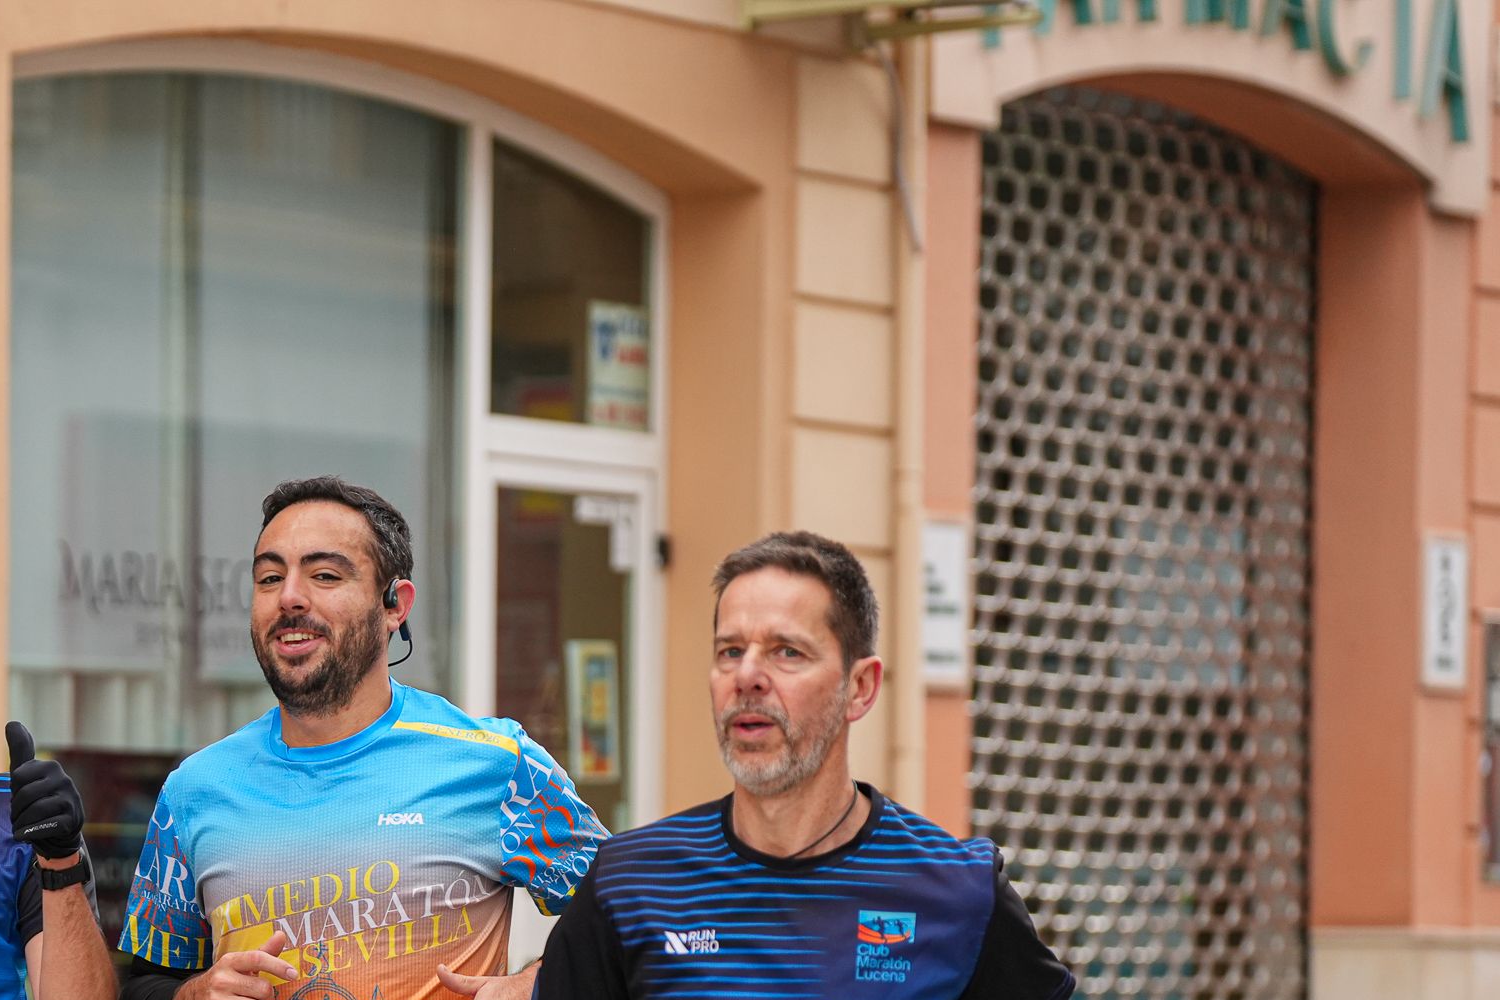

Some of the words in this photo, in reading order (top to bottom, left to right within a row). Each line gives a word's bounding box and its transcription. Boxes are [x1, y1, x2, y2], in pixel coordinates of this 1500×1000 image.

[377, 812, 425, 826] HOKA
[238, 859, 400, 927] MEDIO
[687, 929, 717, 942] RUN
[300, 906, 476, 981] SEVILLA
[690, 940, 720, 954] PRO
[856, 943, 891, 957] Club
[855, 954, 912, 972] Maratón
[855, 967, 907, 983] Lucena
